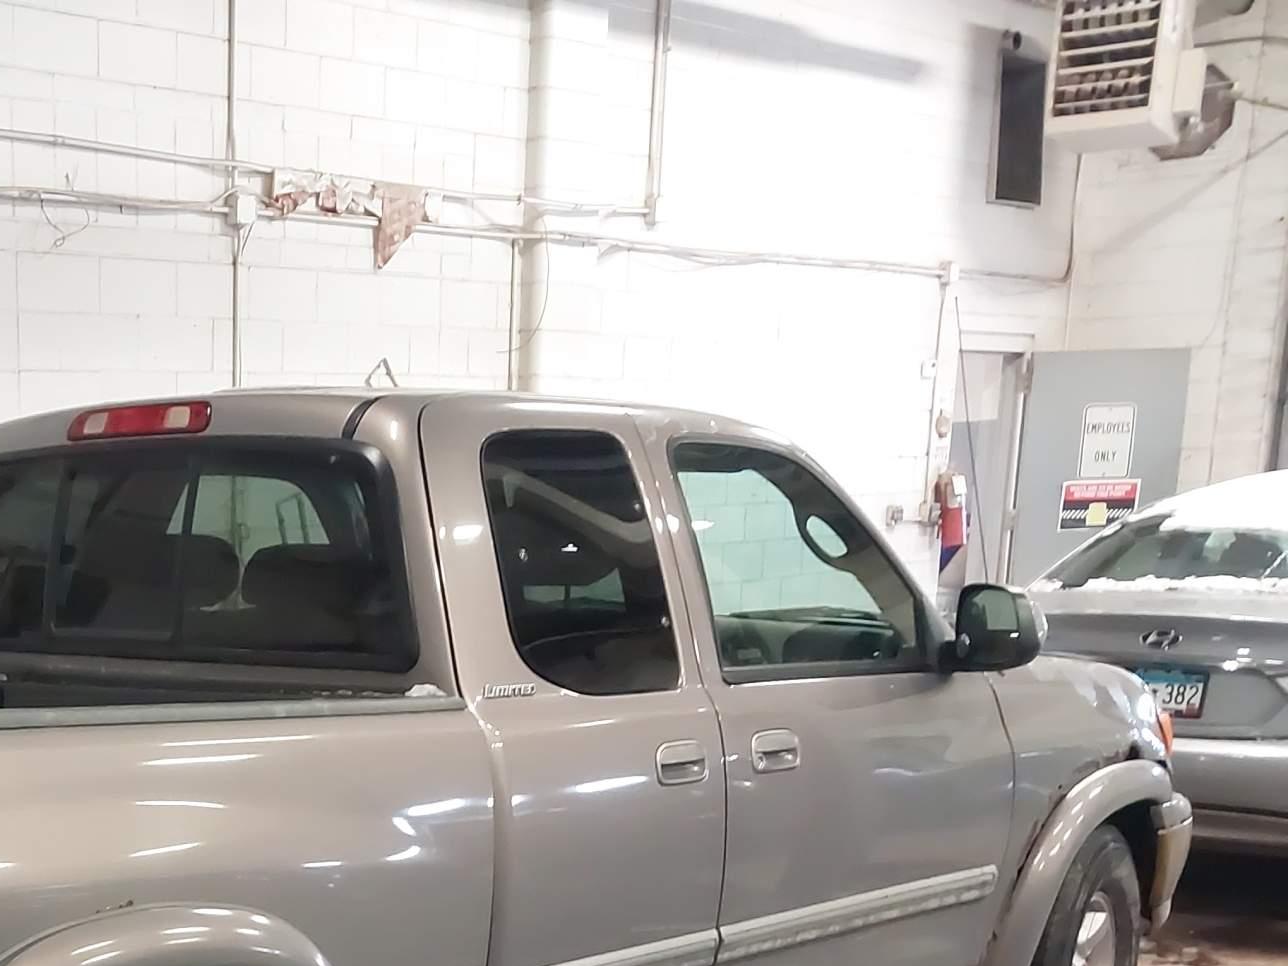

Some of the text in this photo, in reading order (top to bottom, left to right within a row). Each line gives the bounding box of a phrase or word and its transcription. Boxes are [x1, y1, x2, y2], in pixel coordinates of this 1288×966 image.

[1086, 422, 1131, 435] EMPLOYEES
[1094, 450, 1117, 463] ONLY
[483, 682, 537, 699] LIMITED
